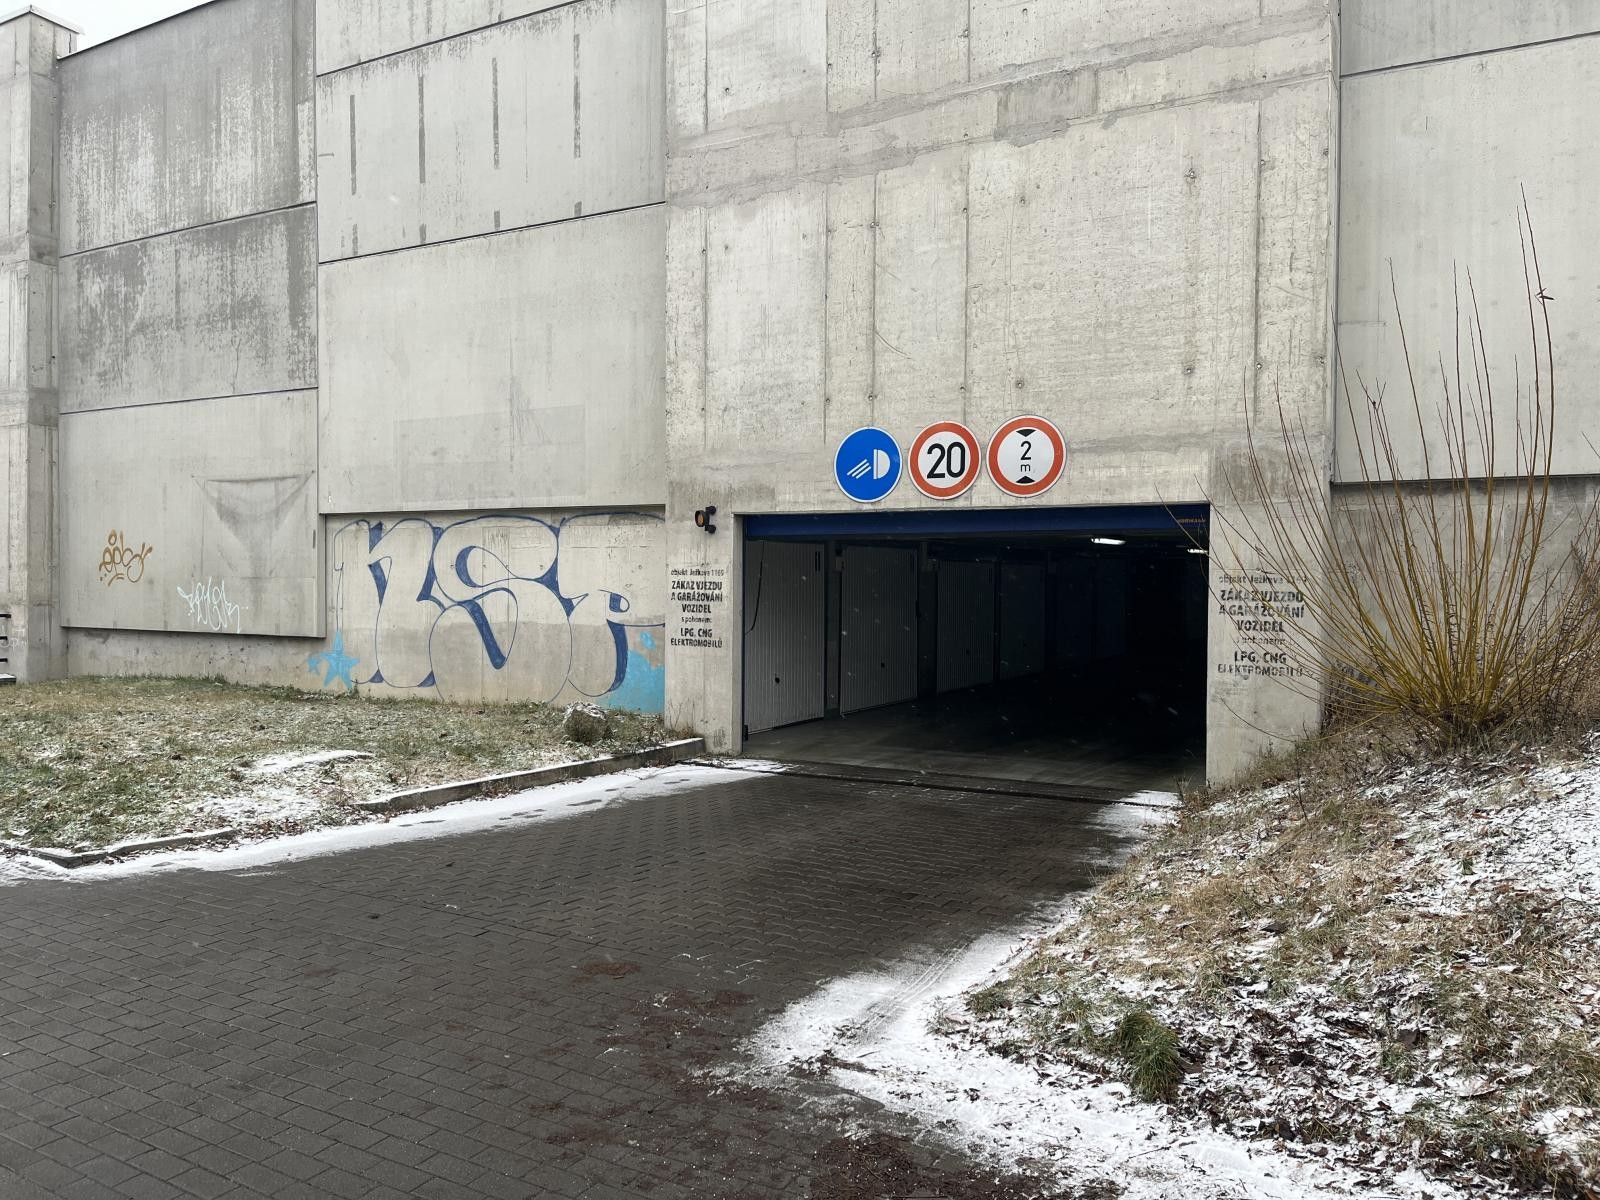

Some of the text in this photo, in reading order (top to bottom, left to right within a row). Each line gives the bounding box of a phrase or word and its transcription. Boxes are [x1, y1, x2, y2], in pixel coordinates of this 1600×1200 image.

[1020, 440, 1032, 461] 2
[926, 441, 966, 479] 20
[1020, 463, 1031, 472] m
[696, 581, 723, 591] VJEZDU
[671, 592, 676, 600] A
[1260, 590, 1304, 603] VJEZDU
[682, 604, 711, 613] VOZIDEL
[1218, 604, 1226, 615] A
[1236, 620, 1286, 633] VOZIDEL
[698, 628, 713, 638] CNG
[1234, 651, 1287, 664] LPG, CNG
